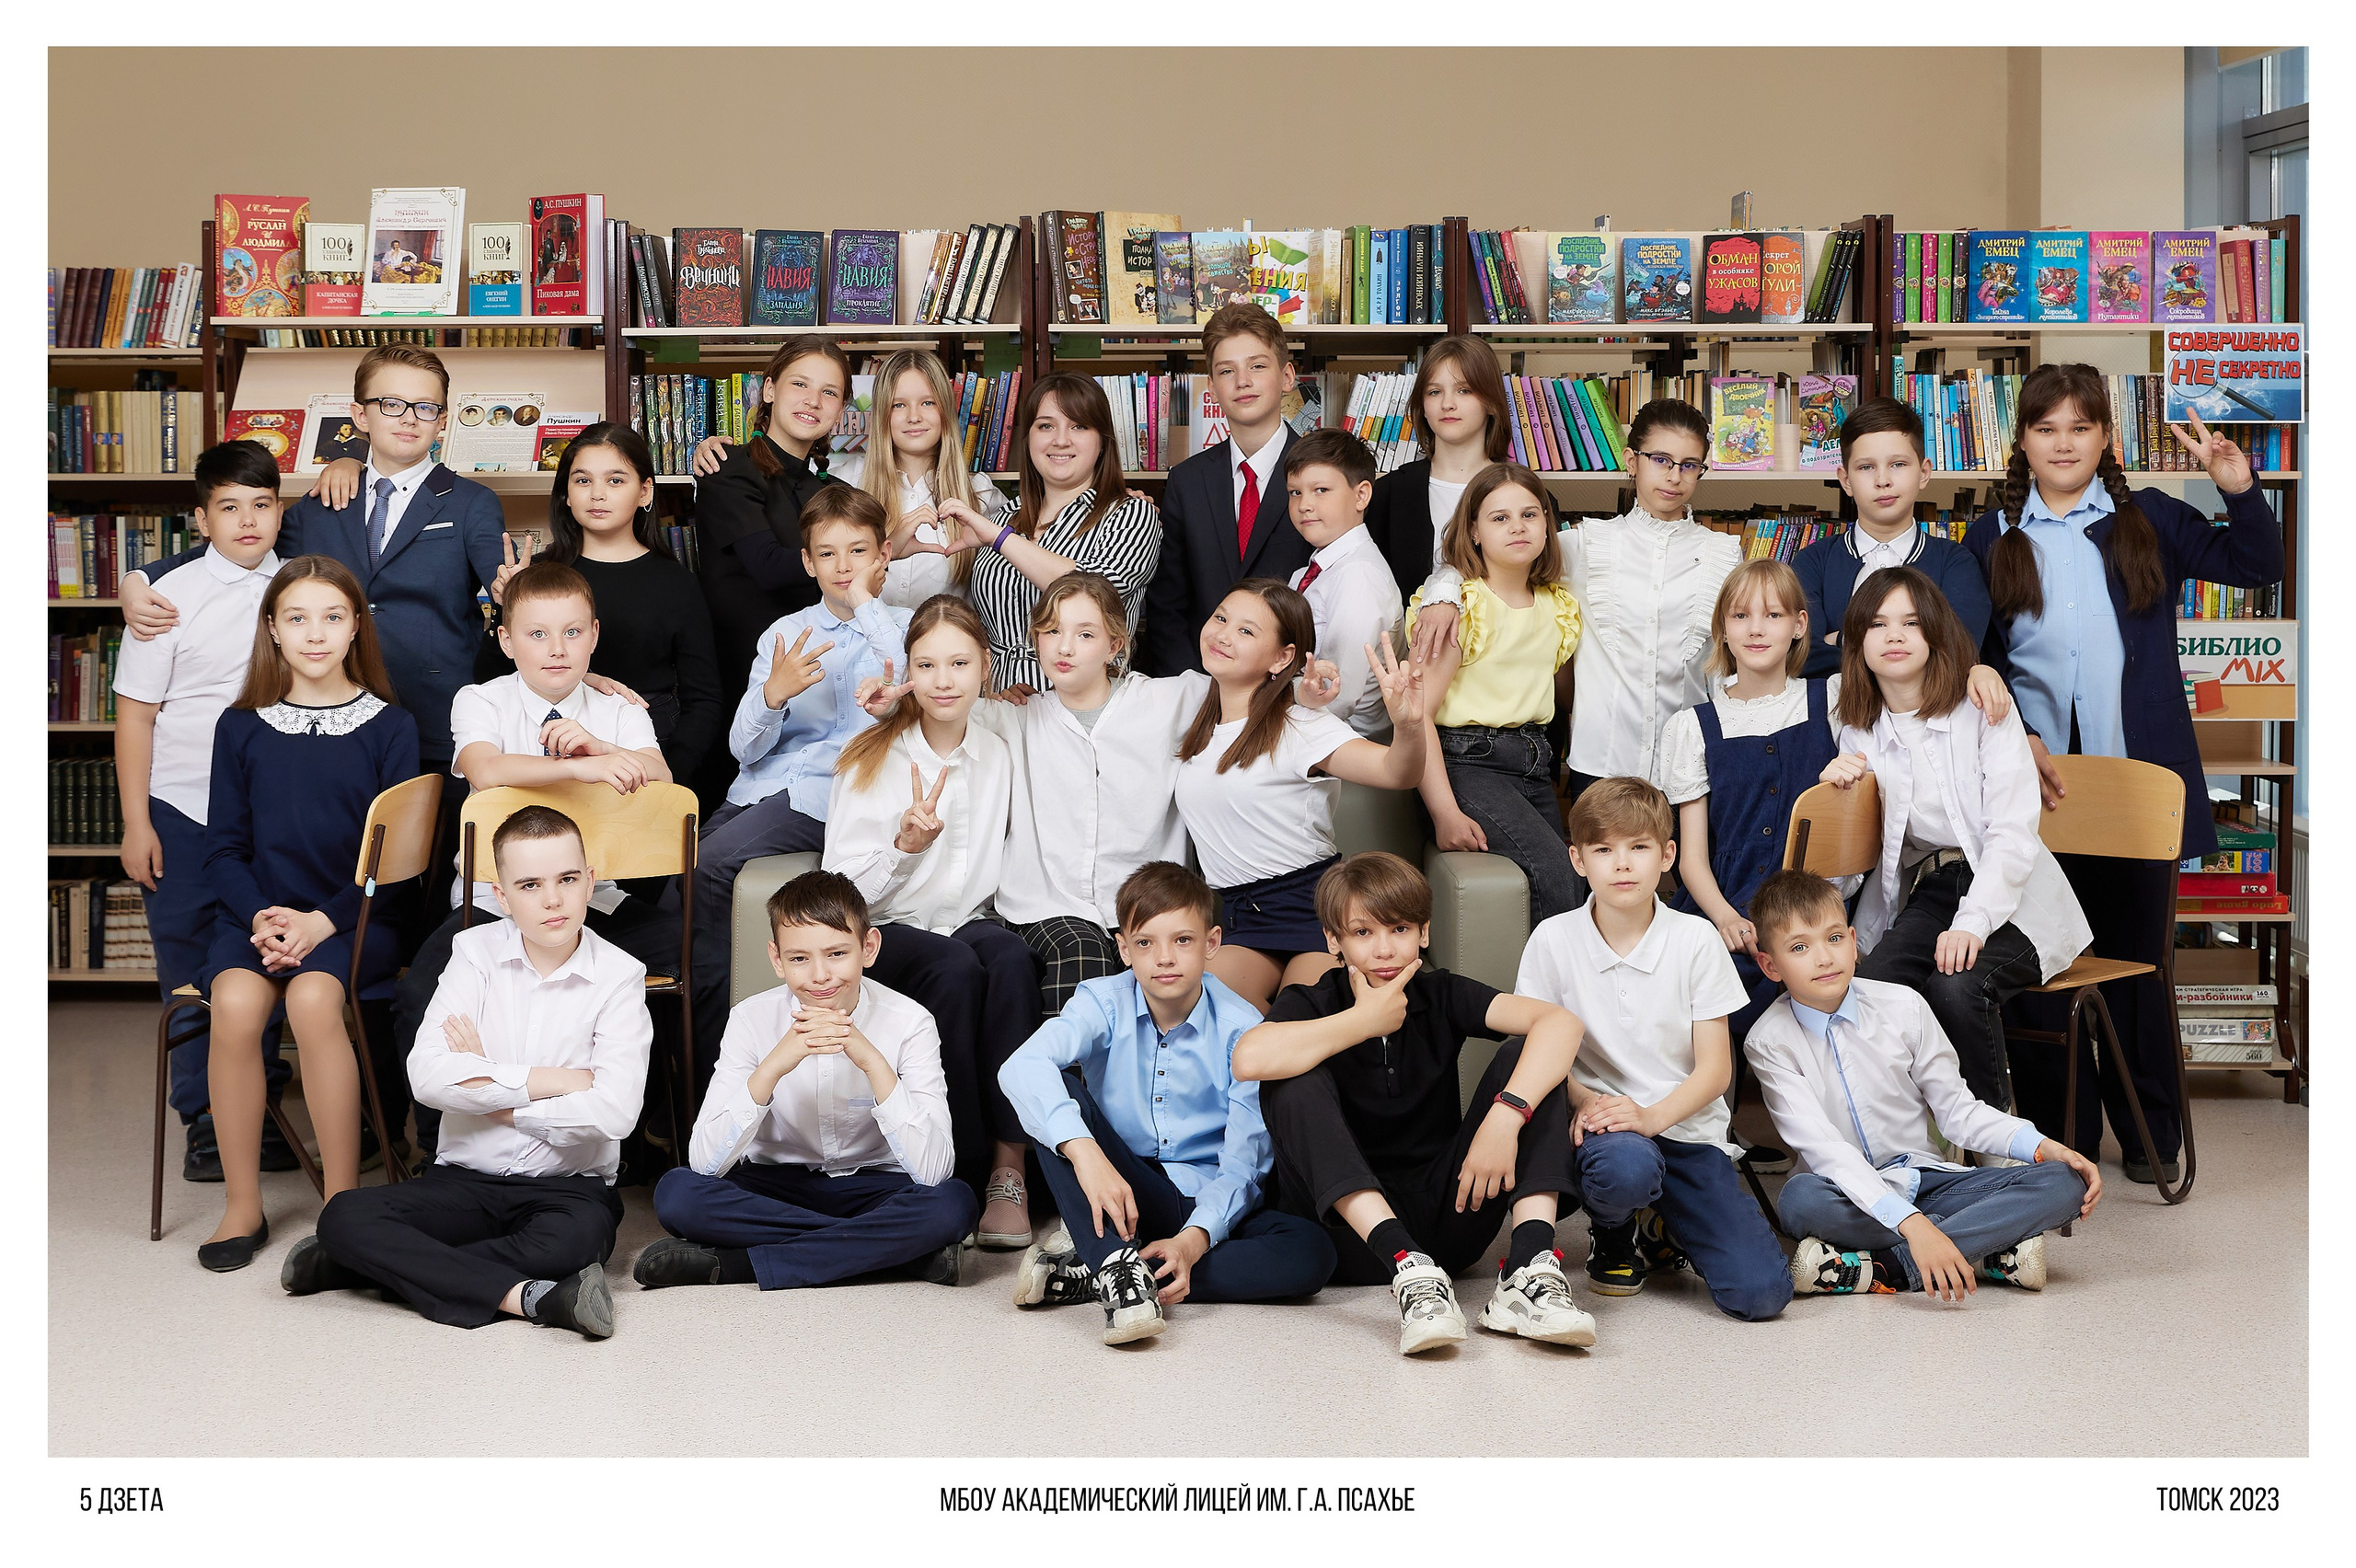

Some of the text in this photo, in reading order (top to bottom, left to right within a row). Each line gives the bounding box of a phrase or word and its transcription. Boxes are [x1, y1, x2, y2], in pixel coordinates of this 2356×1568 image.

[555, 198, 582, 208] ПУШКИН
[247, 221, 287, 231] РУСЛАН
[241, 238, 292, 248] ЛЮДМИЛА
[321, 236, 347, 249] 100
[481, 236, 505, 248] 100
[1978, 236, 2025, 248] ДМИТРИЙ
[2036, 236, 2083, 248] ДМИТРИЙ
[2096, 237, 2142, 248] ДМИТРИЙ
[2163, 237, 2210, 248] ДМИТРИЙ
[1559, 244, 1605, 253] ПОДРОСТКИ
[1637, 250, 1681, 259] ПОДРОСТКИ
[1985, 247, 2020, 259] ЕМЕЦ
[2042, 247, 2077, 259] ЕМЕЦ
[2103, 248, 2138, 259] ЕМЕЦ
[2170, 248, 2204, 259] ЕМЕЦ
[322, 253, 348, 261] КНИГ
[1708, 252, 1759, 267] ОБМАН
[1762, 259, 1801, 275] ОРОЙ
[766, 265, 812, 291] НАВИЯ
[841, 264, 890, 289] НАВИЯ
[1415, 240, 1425, 310] ХРОНИКИ НАРНИИ
[1708, 278, 1759, 290] УЖАСОВ
[537, 288, 580, 299] Пиковая дама
[769, 300, 803, 310] ЗАПАДНЯ
[846, 299, 882, 307] ПРОКЛЯТИЕ
[2044, 307, 2073, 316] Королева
[2097, 313, 2140, 321] Мутантики
[2169, 307, 2202, 316] Сокровища
[2168, 331, 2299, 352] СОВЕРШЕННО
[2170, 359, 2301, 386] НЕ СЕКРЕТНО
[1723, 382, 1759, 396] ВЕСЁЛЫЙ
[1801, 383, 1829, 394] Ситников
[1802, 381, 1819, 389] Юрий
[1729, 388, 1766, 401] ДВОЕЧНИК
[717, 384, 725, 418] КИКИ
[2177, 637, 2281, 656] БИБЛИО
[2220, 657, 2286, 684] MIX
[2253, 852, 2263, 872] 300
[2216, 901, 2282, 910] Ludo game
